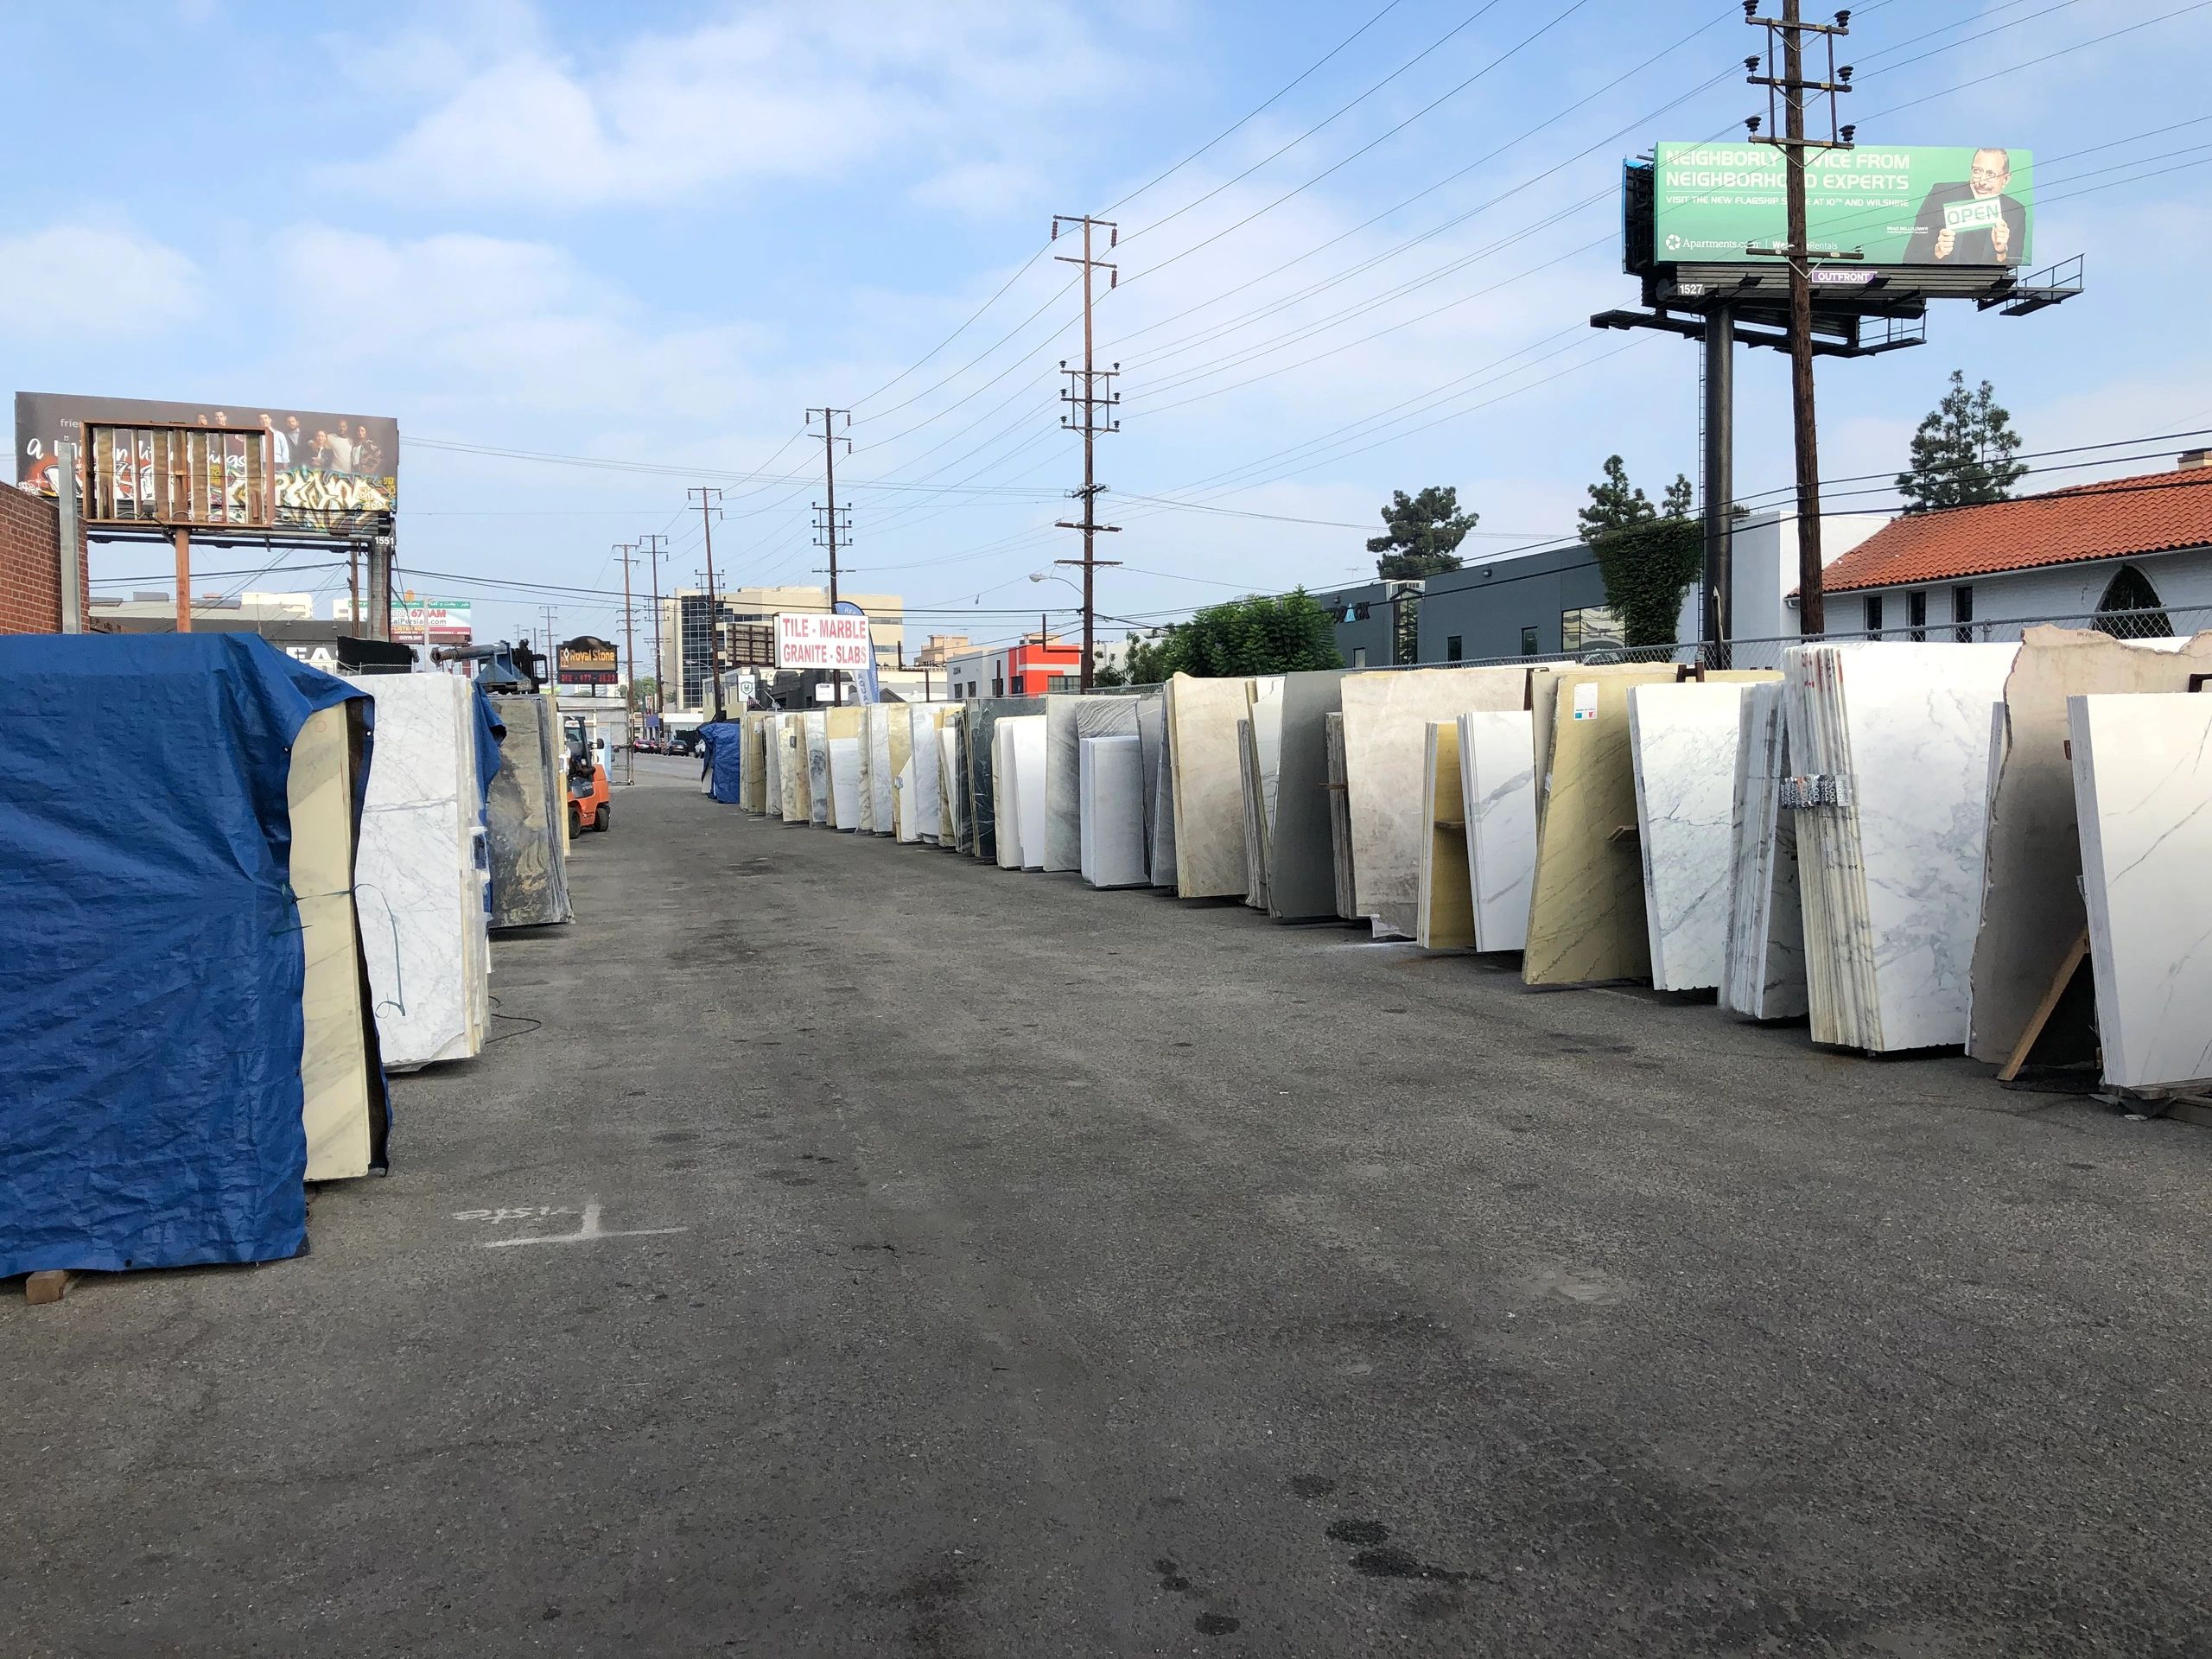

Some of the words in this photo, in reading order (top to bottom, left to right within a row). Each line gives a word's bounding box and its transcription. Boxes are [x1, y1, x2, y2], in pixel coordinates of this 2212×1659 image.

[1666, 149, 1780, 167] NEIGHBORLY
[1804, 152, 1852, 168] DVICE
[1856, 153, 1910, 169] FROM
[1666, 171, 1817, 189] NEIGHBORHOD
[1822, 174, 1909, 190] EXPERTS
[1666, 195, 1688, 204] VISIT
[1692, 195, 1708, 204] THE
[1710, 195, 1732, 204] NEW
[1734, 196, 1779, 205] FLAGSHIP
[1844, 198, 1864, 207] AND
[1866, 199, 1910, 207] WILSHIRE
[1947, 204, 1999, 225] OPEN
[1817, 272, 1870, 282] OUTFRONT
[1679, 284, 1703, 295] 1527
[26, 437, 44, 460] a
[374, 537, 394, 545] 1551
[782, 618, 809, 638] TILE
[819, 619, 867, 639] MARBLE
[569, 649, 592, 664] Royal
[592, 649, 615, 662] Stone
[783, 643, 827, 664] GRANITE
[836, 645, 867, 664] SLABS
